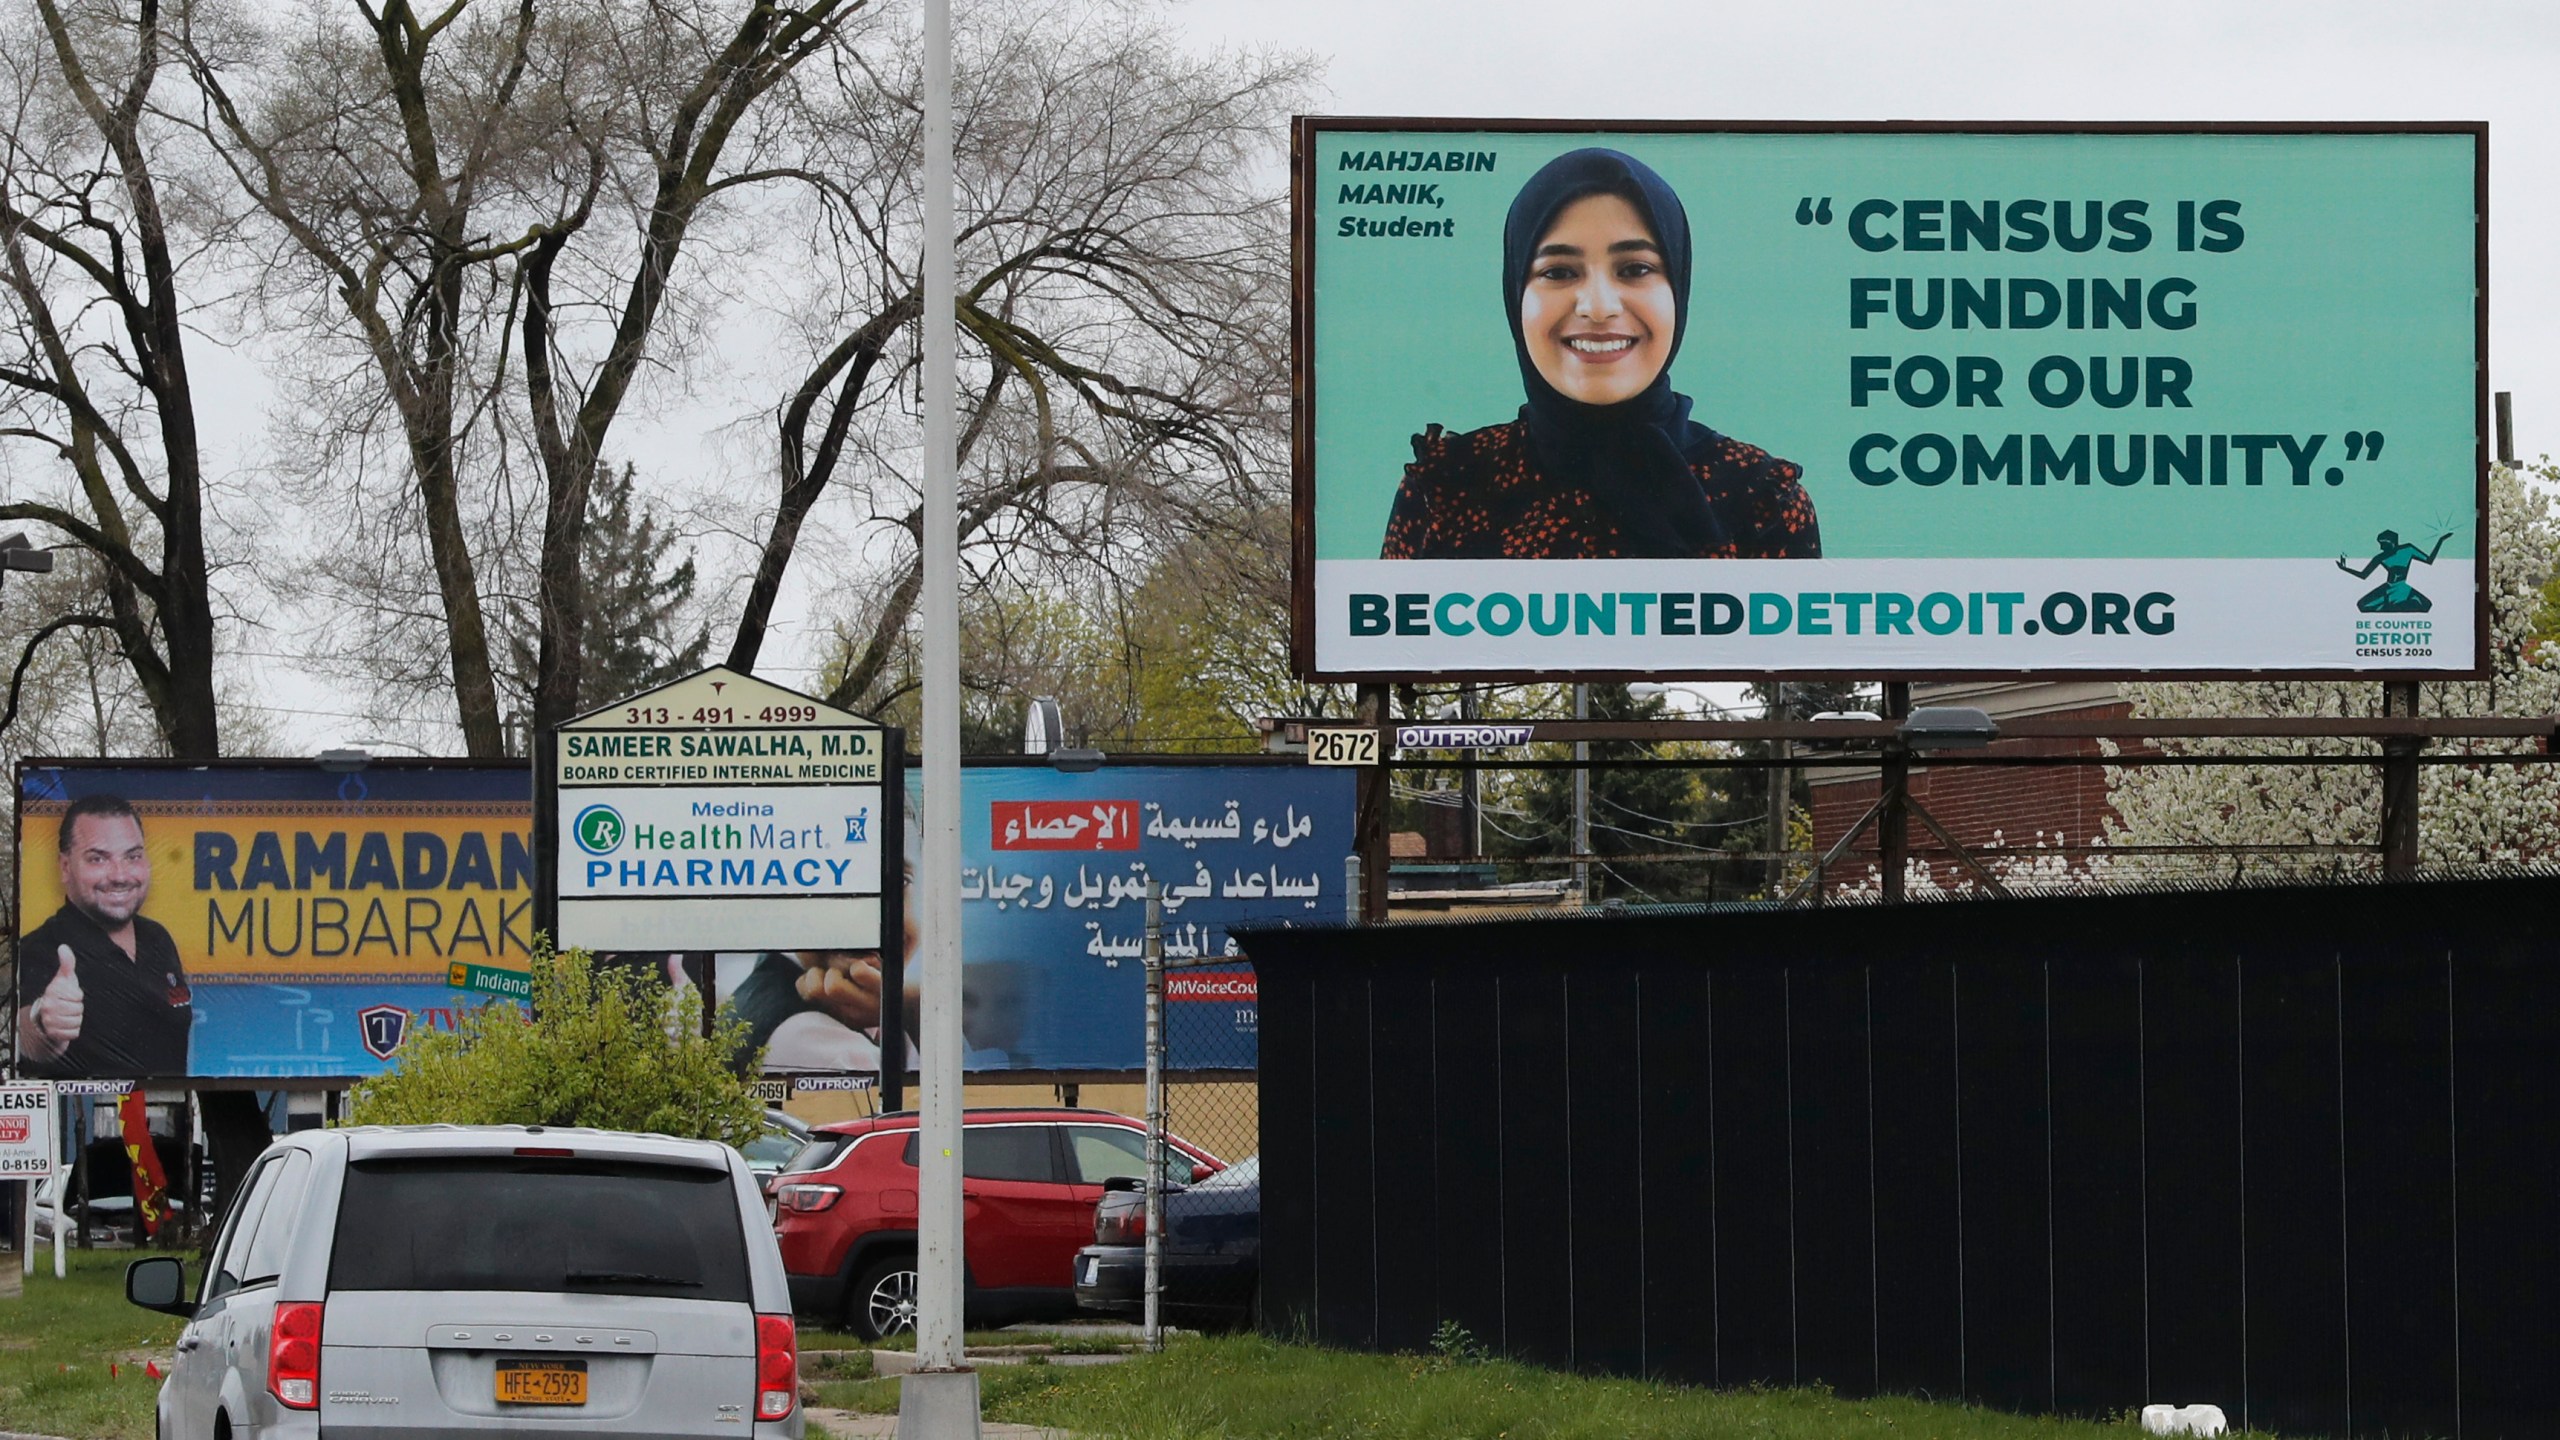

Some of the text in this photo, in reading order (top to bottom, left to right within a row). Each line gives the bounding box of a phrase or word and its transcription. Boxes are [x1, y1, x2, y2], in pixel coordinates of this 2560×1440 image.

[1338, 151, 1497, 174] MAHJABIN
[1338, 183, 1445, 208] MANIK,
[1337, 215, 1455, 239] Student
[2177, 199, 2246, 253] IS
[1849, 277, 2198, 331] FUNDING
[1849, 355, 2194, 409] FOR OUR
[1349, 592, 2176, 637] BECOUNTEDDETROIT.ORG
[2356, 620, 2432, 630] BE COUNTED
[2355, 632, 2433, 645] DETROIT
[2356, 648, 2433, 657] CENSUS 2020
[626, 707, 670, 725] 313
[692, 707, 735, 725] 491
[759, 706, 817, 723] 4999
[567, 734, 874, 760] SAMEER SAWALHA, M.D.
[1314, 733, 1374, 761] 2672
[1401, 729, 1526, 747] OUTFRONT
[564, 764, 876, 779] BOARD CERTIFIED INTERNAL MEDICINE
[692, 801, 774, 817] Medina
[1004, 800, 1312, 850] ملء قسيمة الإحصاء
[193, 831, 532, 891] RAMADAN
[586, 858, 852, 888] PHARMACY
[1063, 862, 1150, 910] تمويل
[1161, 860, 1212, 914] في
[1222, 863, 1320, 908] يساعد
[207, 897, 532, 957] MUBARAK
[475, 970, 530, 995] Indiana
[57, 1081, 130, 1093] OUTFRONT
[750, 1082, 784, 1099] 2669
[798, 1079, 869, 1090] OUTFRONT
[0, 1093, 47, 1109] EASE
[453, 1332, 632, 1344] DODGE
